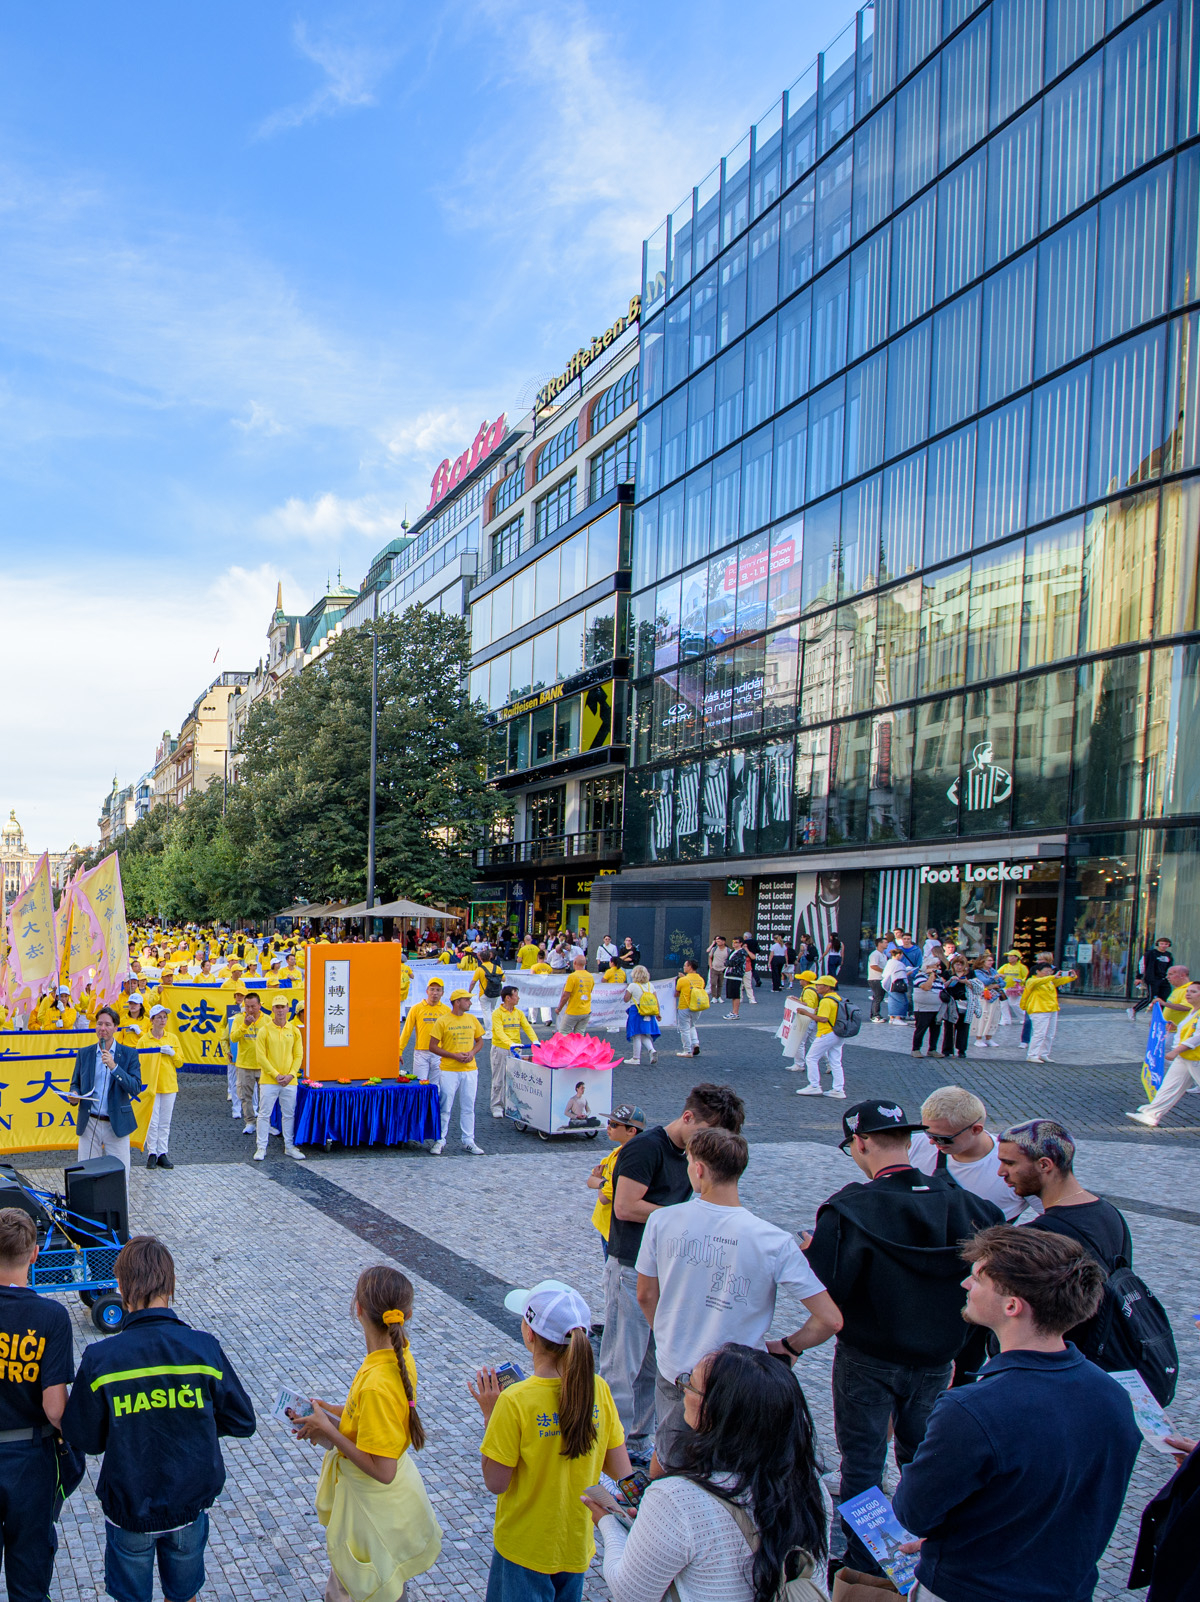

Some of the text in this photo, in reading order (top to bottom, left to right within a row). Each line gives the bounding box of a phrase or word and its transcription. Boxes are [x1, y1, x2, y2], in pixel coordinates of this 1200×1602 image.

[547, 315, 623, 402] Raiffeisen
[503, 683, 564, 720] Raiffeisen BANK
[714, 693, 751, 712] rodnné
[920, 861, 1034, 884] Foot Locker
[772, 892, 793, 900] Locker
[772, 902, 792, 910] Locker
[771, 923, 792, 931] Locker
[770, 933, 791, 941] Ler
[328, 985, 345, 1035] 轉法輪
[513, 1082, 543, 1097] FALUN DAFA
[36, 1112, 77, 1128] DA
[713, 1236, 738, 1246] celestial
[711, 1265, 751, 1306] sky
[113, 1384, 205, 1417] HASIČI
[851, 1499, 880, 1518] TIAN GUO
[855, 1506, 887, 1526] MARCHING
[867, 1516, 886, 1530] BAND
